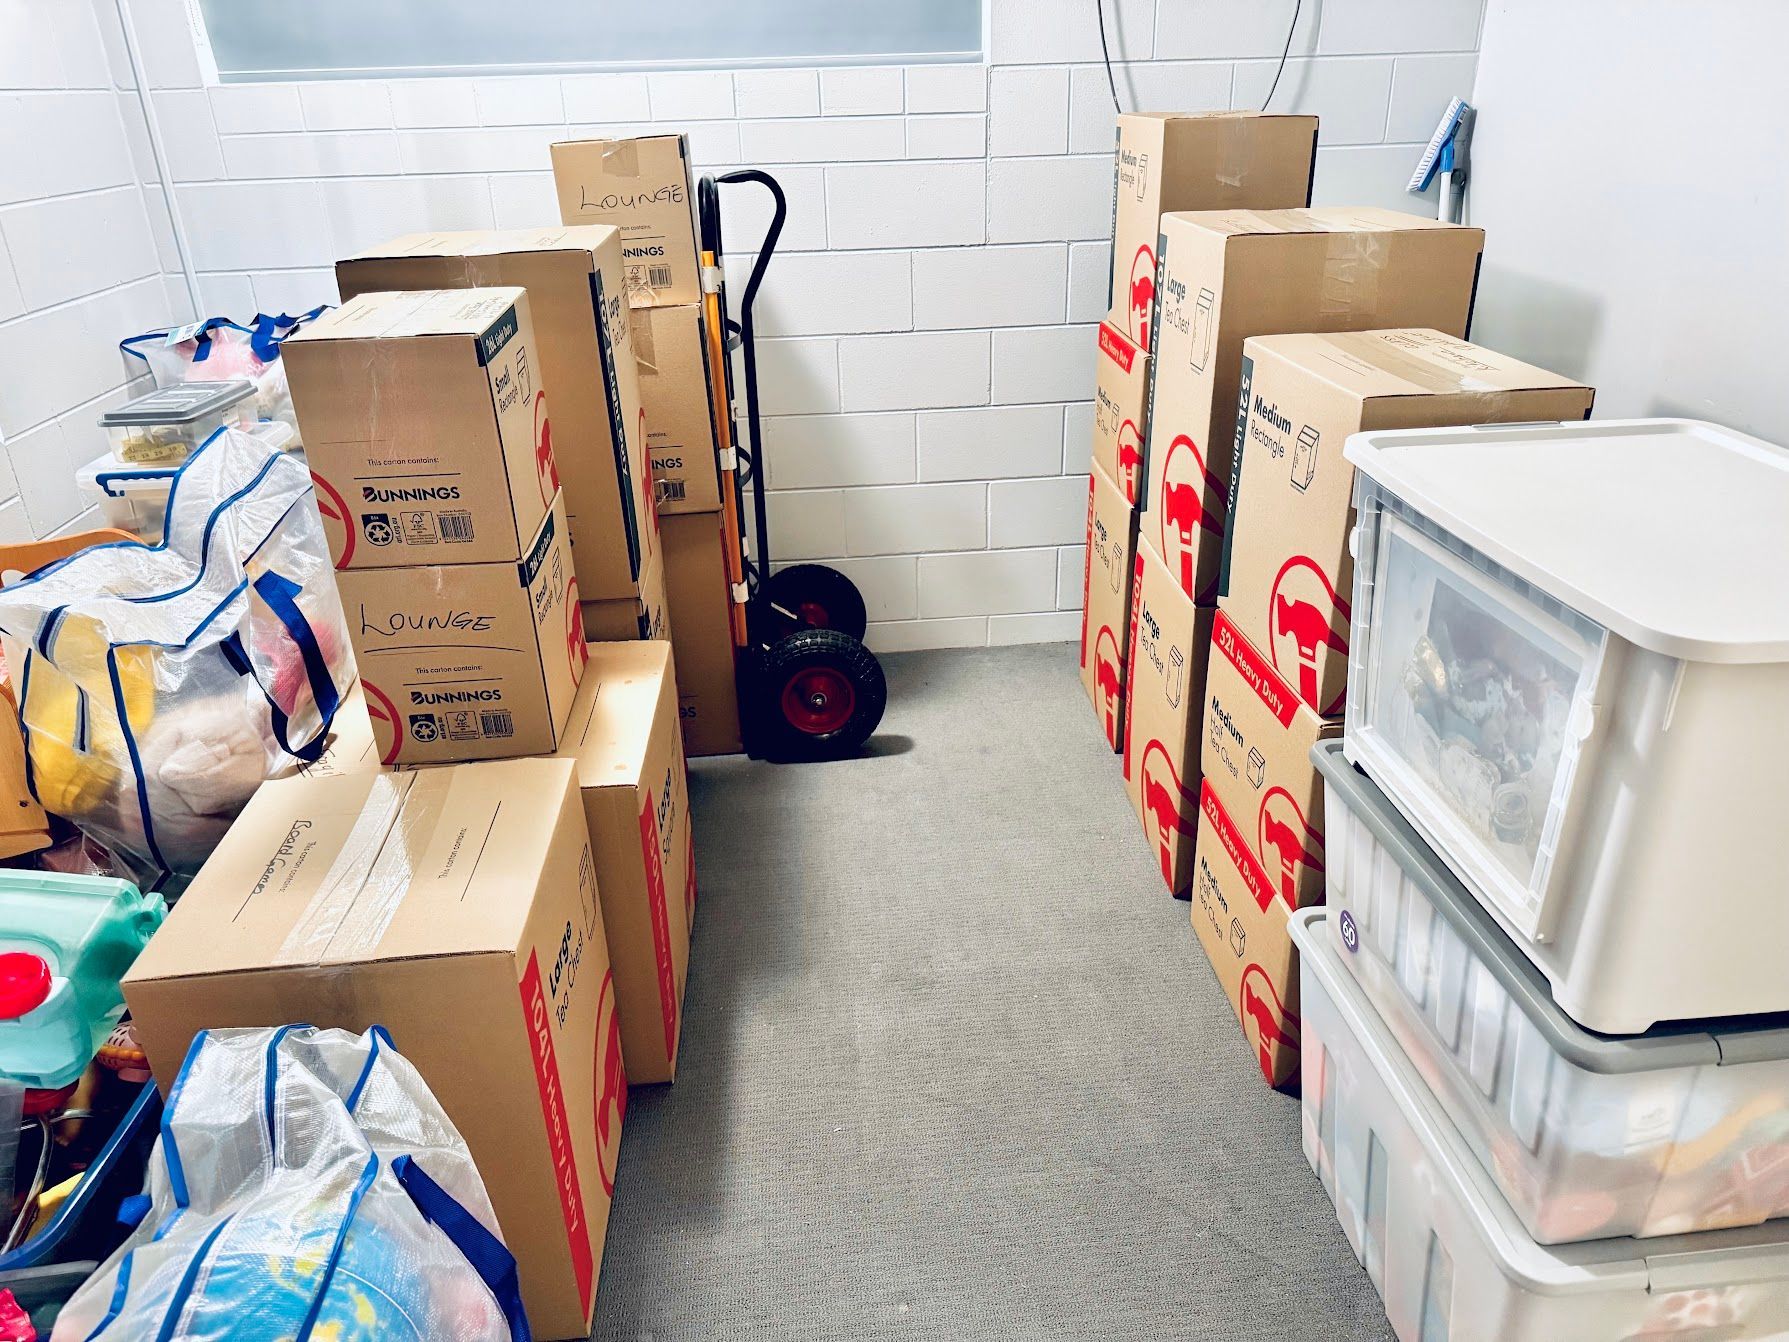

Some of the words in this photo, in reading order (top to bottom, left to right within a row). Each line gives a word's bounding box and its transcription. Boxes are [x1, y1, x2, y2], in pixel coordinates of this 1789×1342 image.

[1121, 149, 1137, 167] Medium
[580, 184, 684, 210] LOUNGE
[622, 246, 665, 258] NNINGS
[1154, 254, 1165, 318] 107L
[1167, 270, 1186, 304] Large
[1164, 301, 1175, 325] Tea
[1174, 306, 1191, 335] Chest
[495, 364, 511, 395] Small
[1238, 374, 1250, 420] 52L
[1253, 395, 1292, 435] Medium
[1233, 427, 1243, 468] Light
[1250, 419, 1285, 459] Rectangle
[368, 458, 382, 466] This
[651, 458, 683, 470] INGS
[363, 486, 460, 503] BUNNINGS
[1227, 473, 1238, 514] Duty
[1095, 512, 1107, 542] Large
[1131, 574, 1142, 624] 104L
[362, 604, 497, 636] LOUNGE
[1142, 601, 1160, 640] Large
[1141, 627, 1149, 651] Tea
[1149, 642, 1164, 676] Chest
[1219, 627, 1236, 657] 52L
[1235, 650, 1262, 692] Heavy
[1262, 680, 1284, 716] Duty
[410, 690, 502, 705] BUNNINGS
[1210, 715, 1224, 740] Half
[1211, 695, 1244, 748] Medium
[1210, 729, 1220, 753] Tea
[1220, 747, 1239, 779] Chest
[279, 819, 312, 855] Board
[304, 841, 317, 852] This
[1206, 796, 1220, 830] 52L
[1220, 824, 1242, 868] Heavy
[1242, 861, 1261, 898] Duty
[294, 852, 308, 869] carton
[438, 869, 450, 879] This
[446, 850, 458, 868] carton
[1201, 856, 1228, 914] Medium
[1208, 906, 1223, 940] Chest
[1343, 920, 1356, 945] 60
[549, 920, 572, 1000] Large
[555, 991, 569, 1030] Tea
[567, 928, 583, 988] Chest
[531, 982, 550, 1078] 104L
[547, 1074, 566, 1168] Heavy
[564, 1164, 578, 1232] Duty
